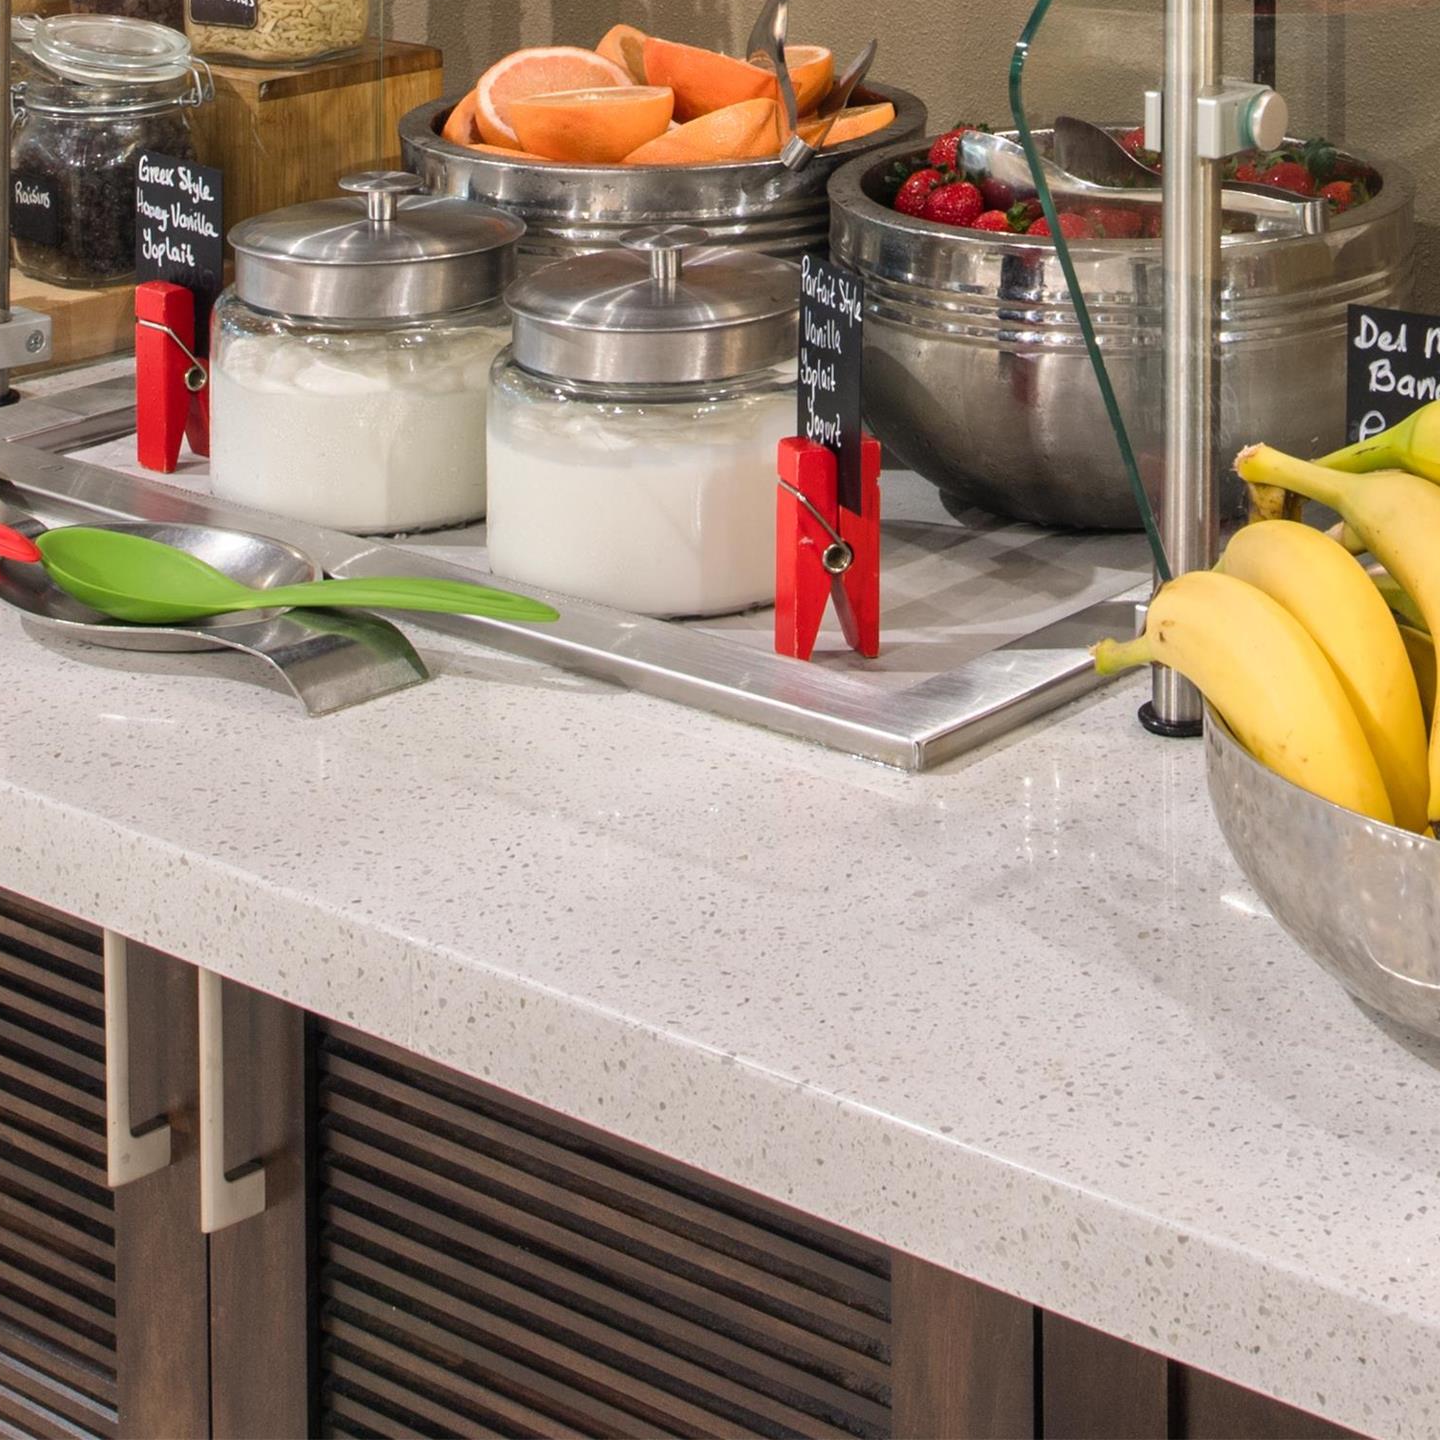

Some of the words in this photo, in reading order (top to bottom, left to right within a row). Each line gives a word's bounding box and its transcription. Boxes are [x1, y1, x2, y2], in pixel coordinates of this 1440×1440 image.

[14, 181, 51, 208] Raisins
[138, 155, 175, 188] Greek
[177, 166, 215, 205] Style
[136, 186, 170, 233] Honey
[170, 202, 219, 238] Vanilla
[142, 227, 195, 268] Yoplait
[801, 254, 836, 309] Parfait
[838, 278, 863, 329] Style
[804, 306, 842, 355] Vanilla
[1353, 314, 1407, 353] Del
[800, 347, 836, 403] Yoplait
[806, 396, 842, 448] Yogurt
